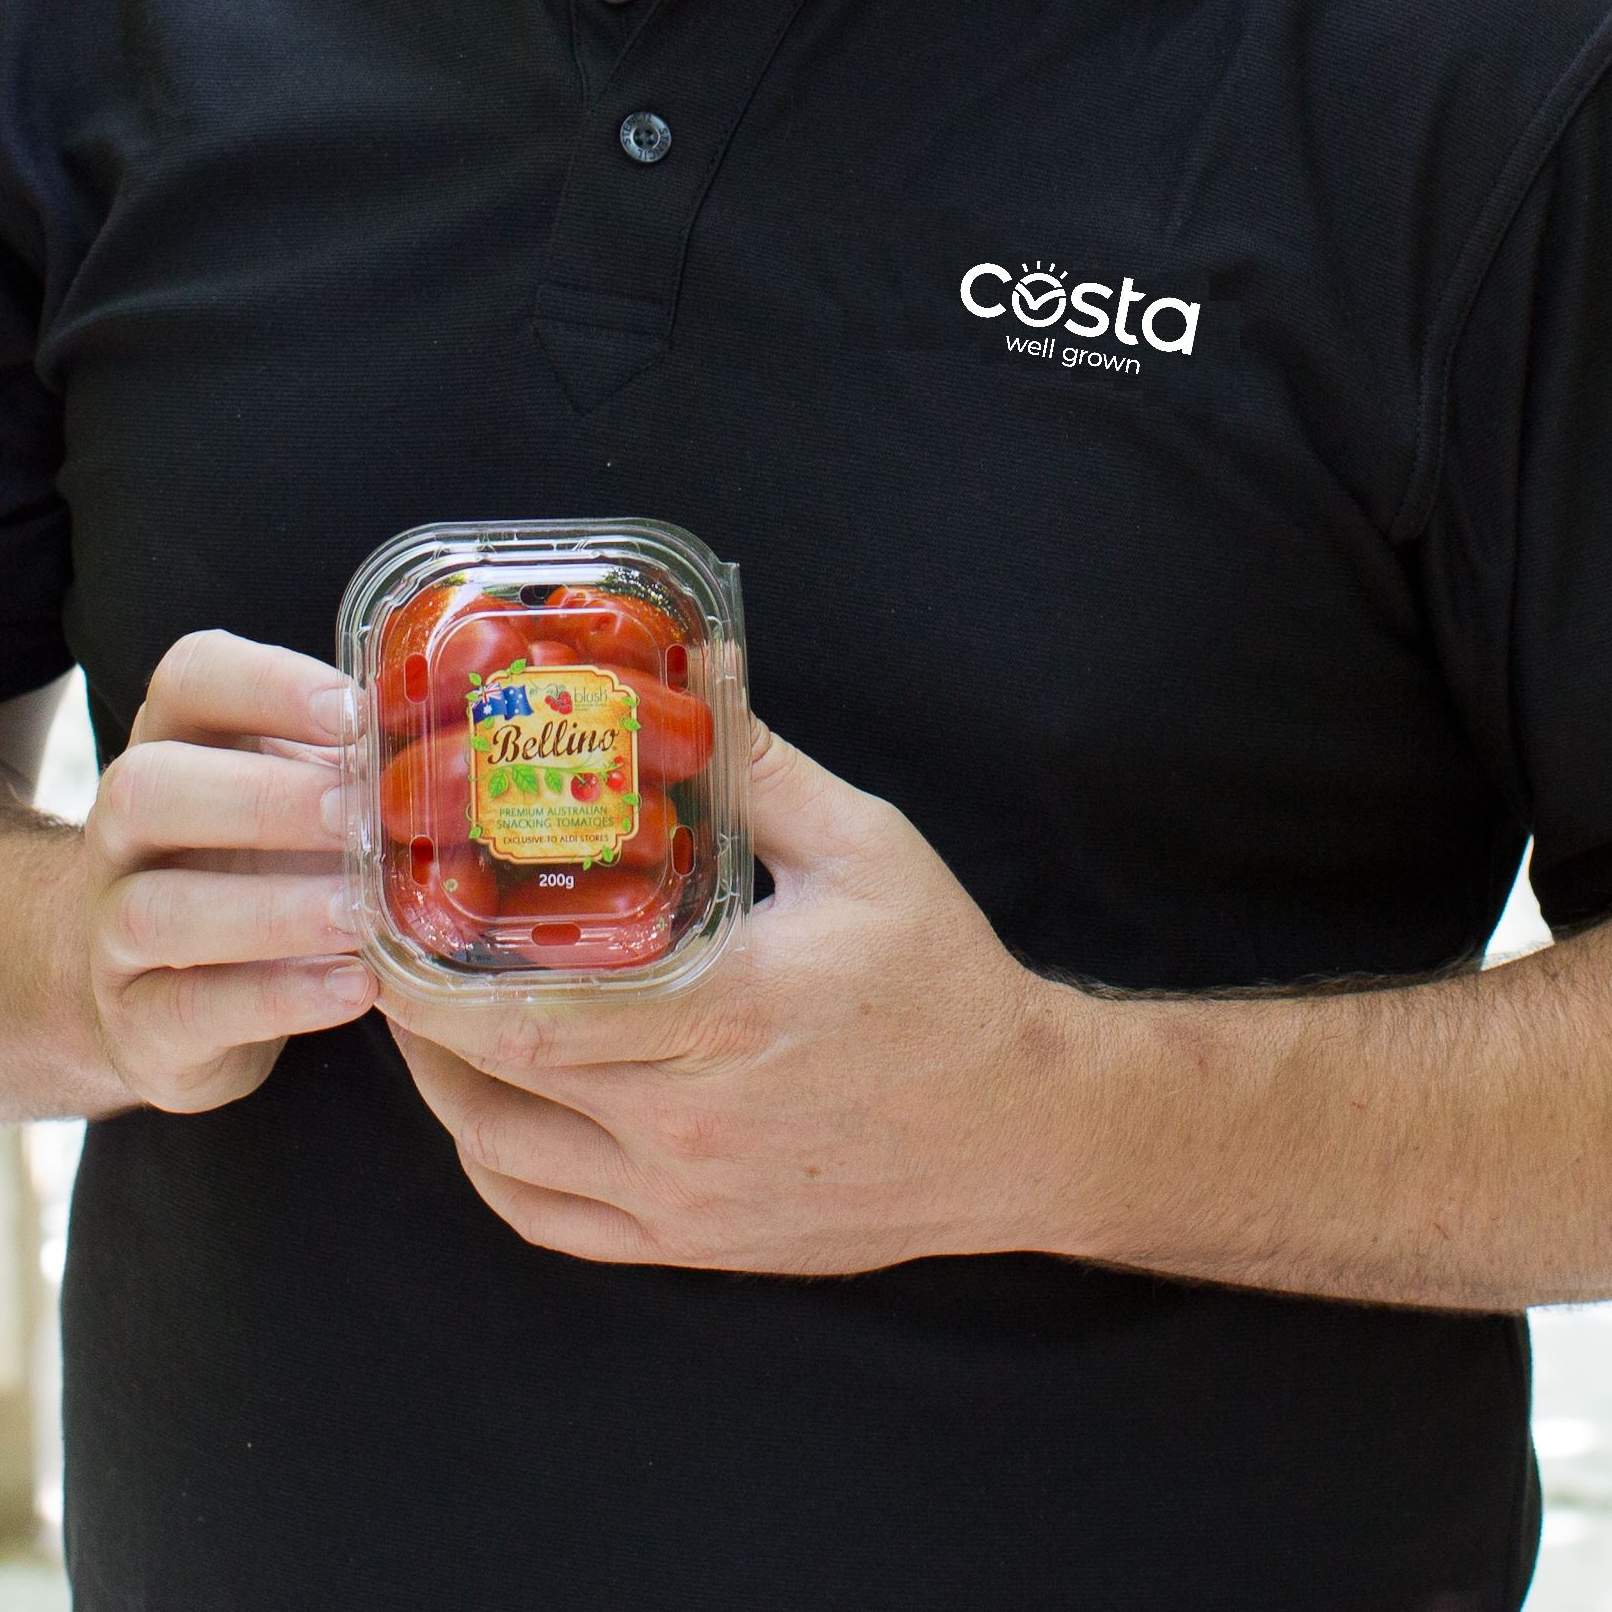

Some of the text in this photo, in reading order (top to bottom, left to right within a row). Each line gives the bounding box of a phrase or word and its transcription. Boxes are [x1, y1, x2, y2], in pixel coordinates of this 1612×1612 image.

[960, 262, 1201, 356] costa
[1005, 335, 1142, 375] well grown
[574, 686, 607, 702] blush
[487, 719, 620, 765] Bellino
[499, 806, 608, 817] PREMIUM AUSTRALIAN
[496, 817, 614, 829] SNACKING TOMATOES
[503, 834, 609, 844] EXCLUSIVE TO ALDI STORES
[539, 873, 574, 889] 200g
